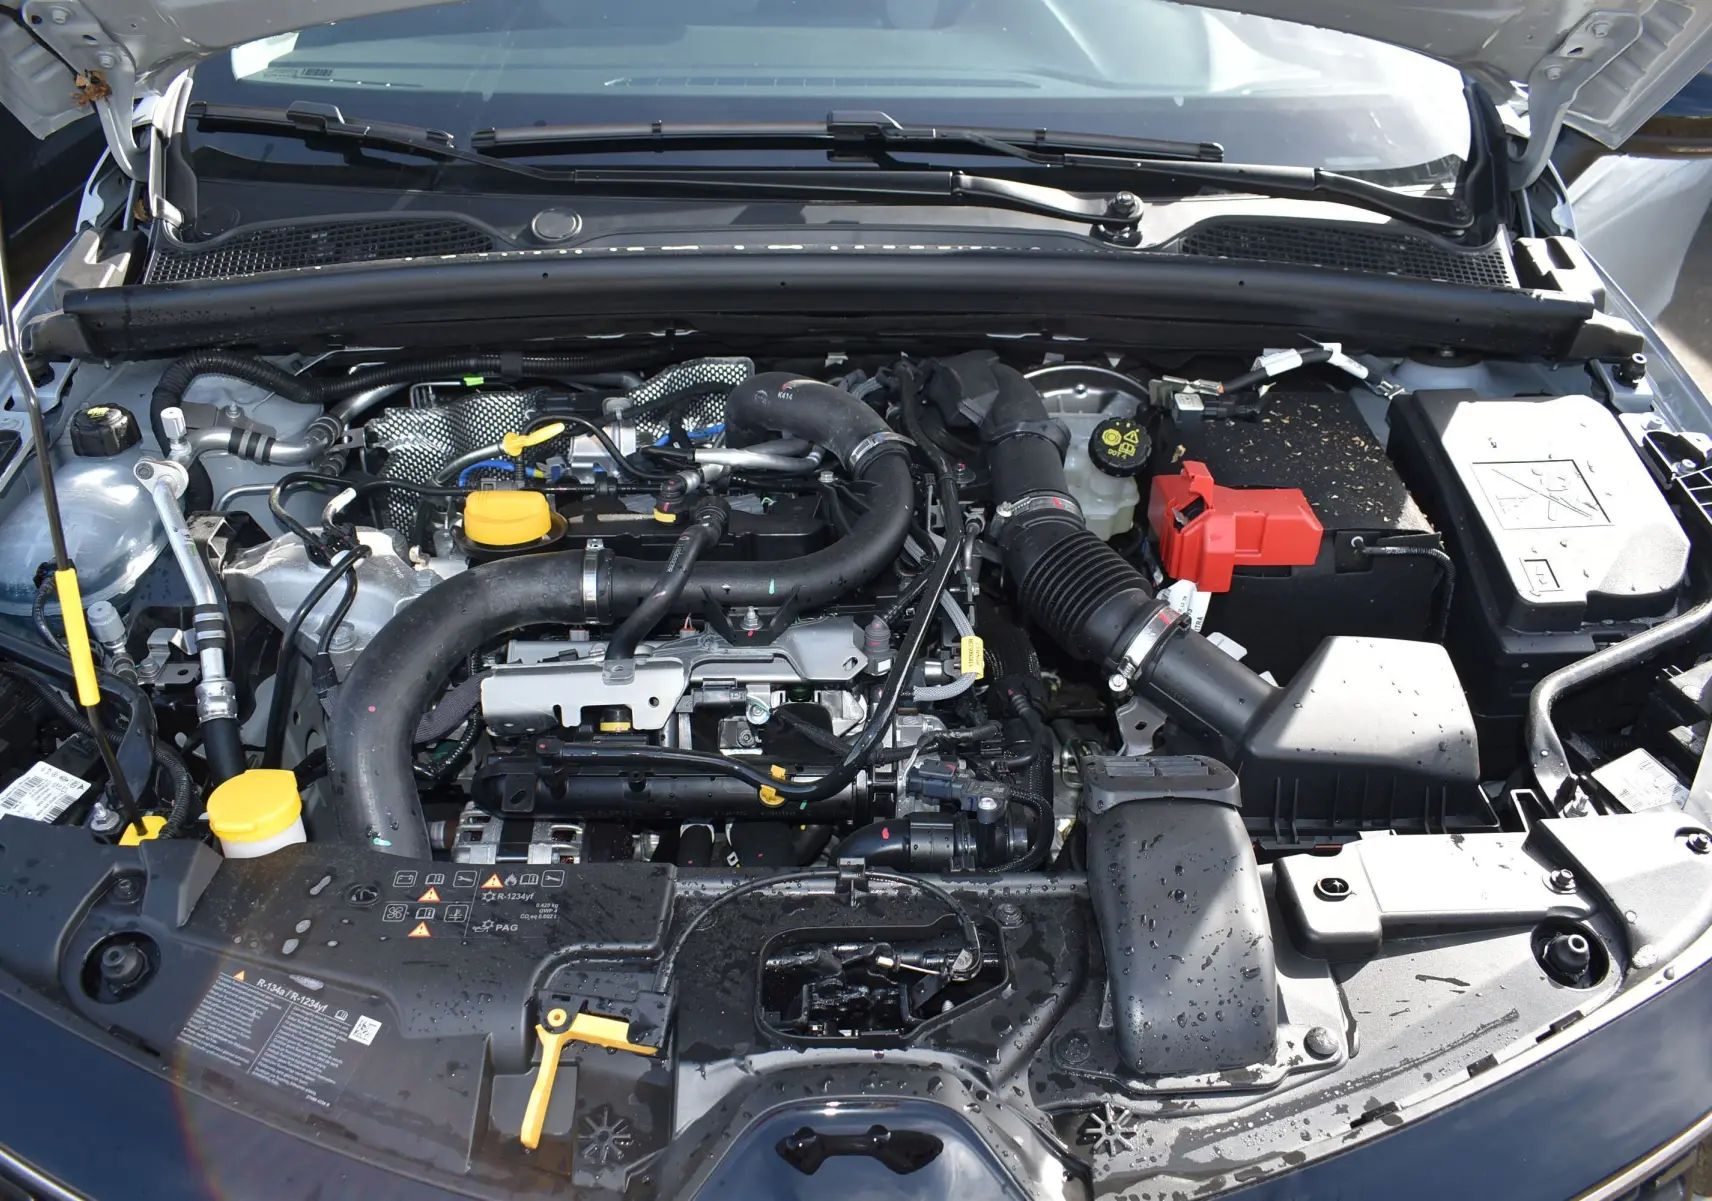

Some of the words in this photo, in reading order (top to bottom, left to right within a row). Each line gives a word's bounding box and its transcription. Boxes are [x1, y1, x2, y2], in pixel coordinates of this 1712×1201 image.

[777, 391, 793, 400] K414
[1107, 448, 1121, 457] DOT
[497, 892, 535, 901] R-1234yf
[495, 924, 519, 932] PAG
[256, 978, 286, 996] R-134a
[289, 991, 329, 1013] R-1234yf
